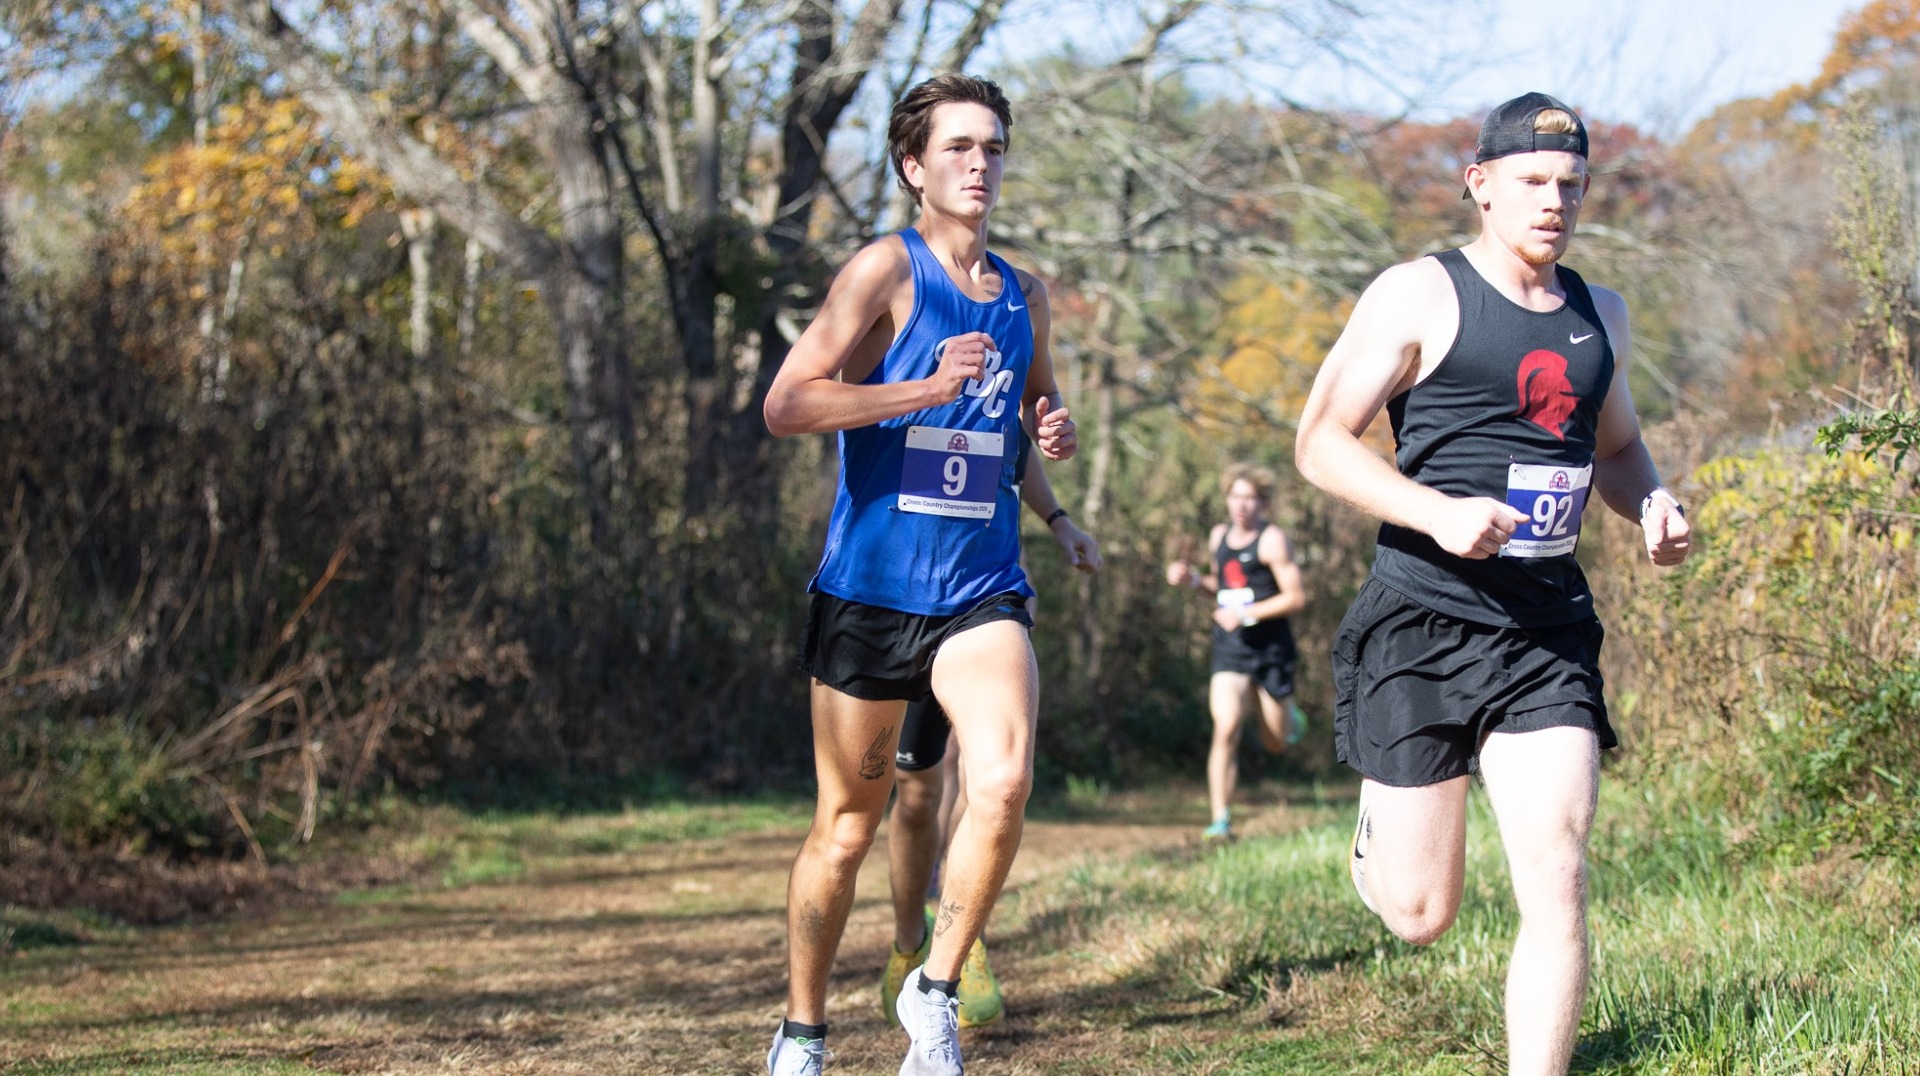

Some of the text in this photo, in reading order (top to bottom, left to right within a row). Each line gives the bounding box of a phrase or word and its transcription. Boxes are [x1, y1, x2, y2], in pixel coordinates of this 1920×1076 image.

[935, 337, 1014, 418] BC
[942, 455, 968, 496] 9
[906, 498, 922, 506] Cross
[922, 500, 943, 509] Country
[943, 502, 979, 512] Championships
[1531, 493, 1574, 537] 92
[1508, 542, 1523, 550] Cross
[1523, 543, 1541, 551] Country
